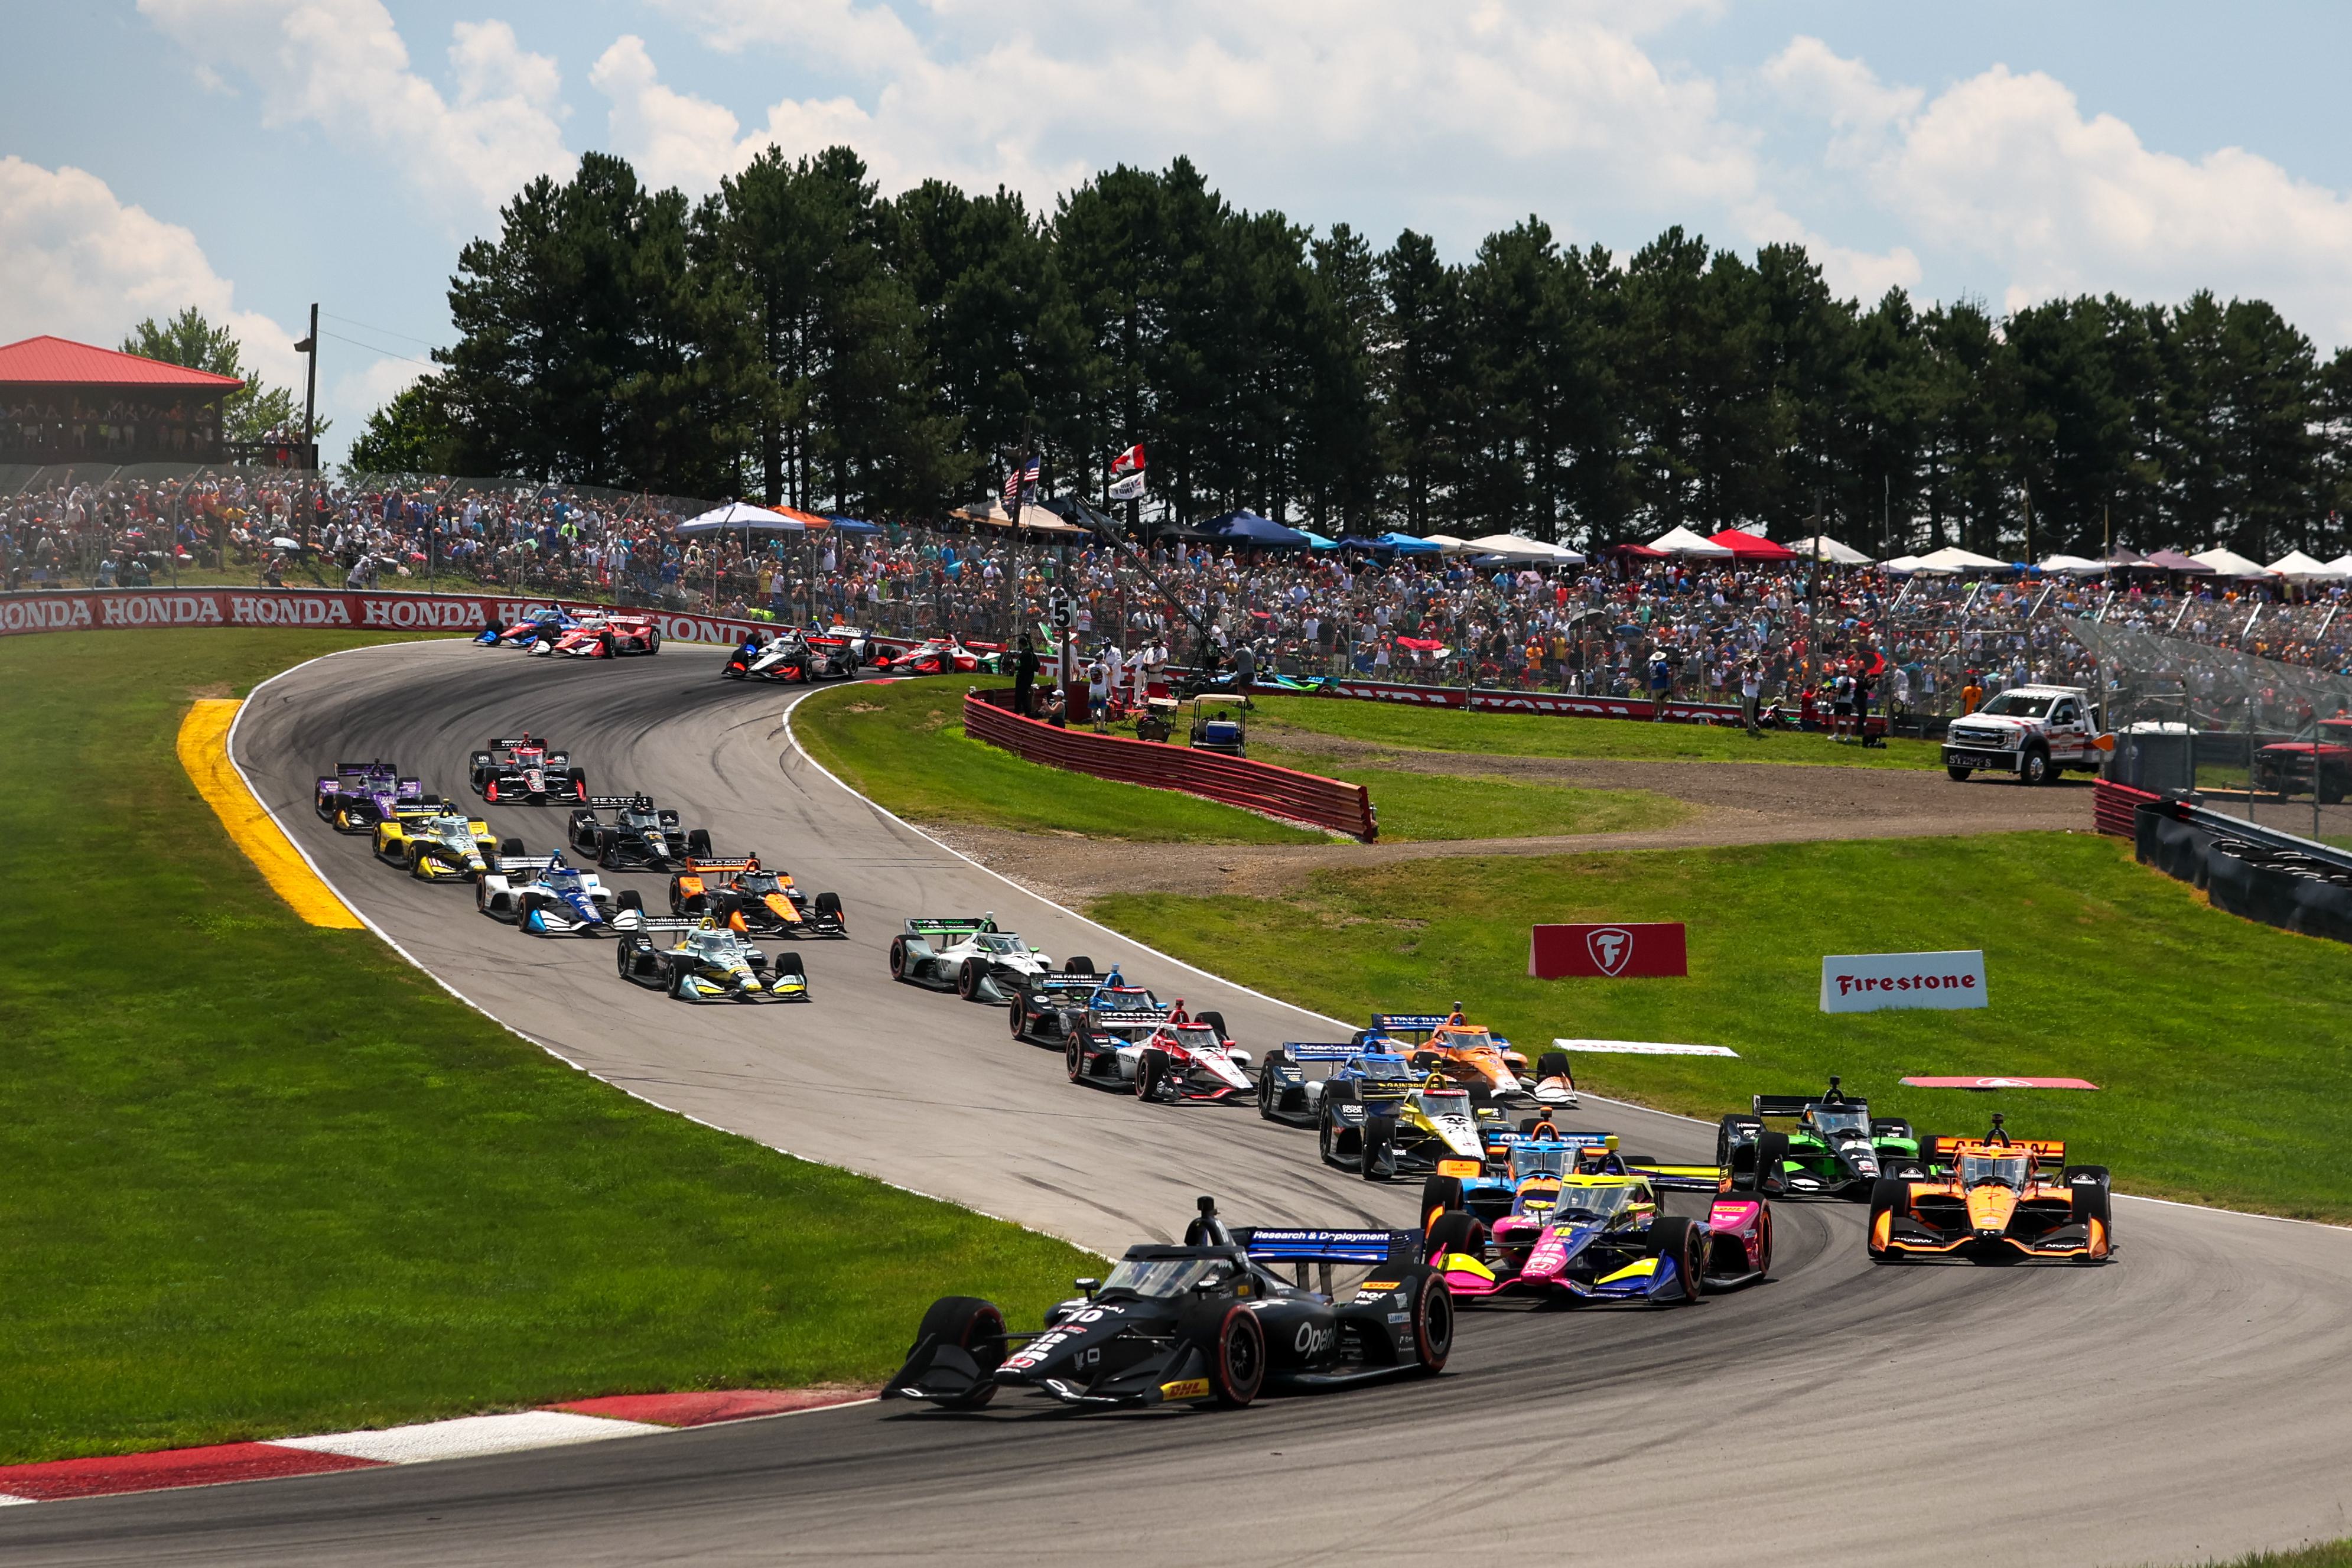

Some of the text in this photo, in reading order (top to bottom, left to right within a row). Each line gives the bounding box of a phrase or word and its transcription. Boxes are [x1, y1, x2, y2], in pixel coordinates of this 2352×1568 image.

[0, 600, 92, 630] ONDA
[102, 597, 223, 624] HONDA
[231, 597, 352, 624] HONDA
[362, 600, 492, 627] HONDA
[1054, 600, 1071, 627] 5
[1836, 973, 1976, 996] Firestone
[1300, 1044, 1362, 1053] Spectrum
[1447, 1125, 1476, 1134] 26
[1253, 1231, 1306, 1240] Research
[1319, 1232, 1389, 1241] Deployment
[1065, 1309, 1103, 1322] 10
[1169, 1382, 1202, 1397] DHL
